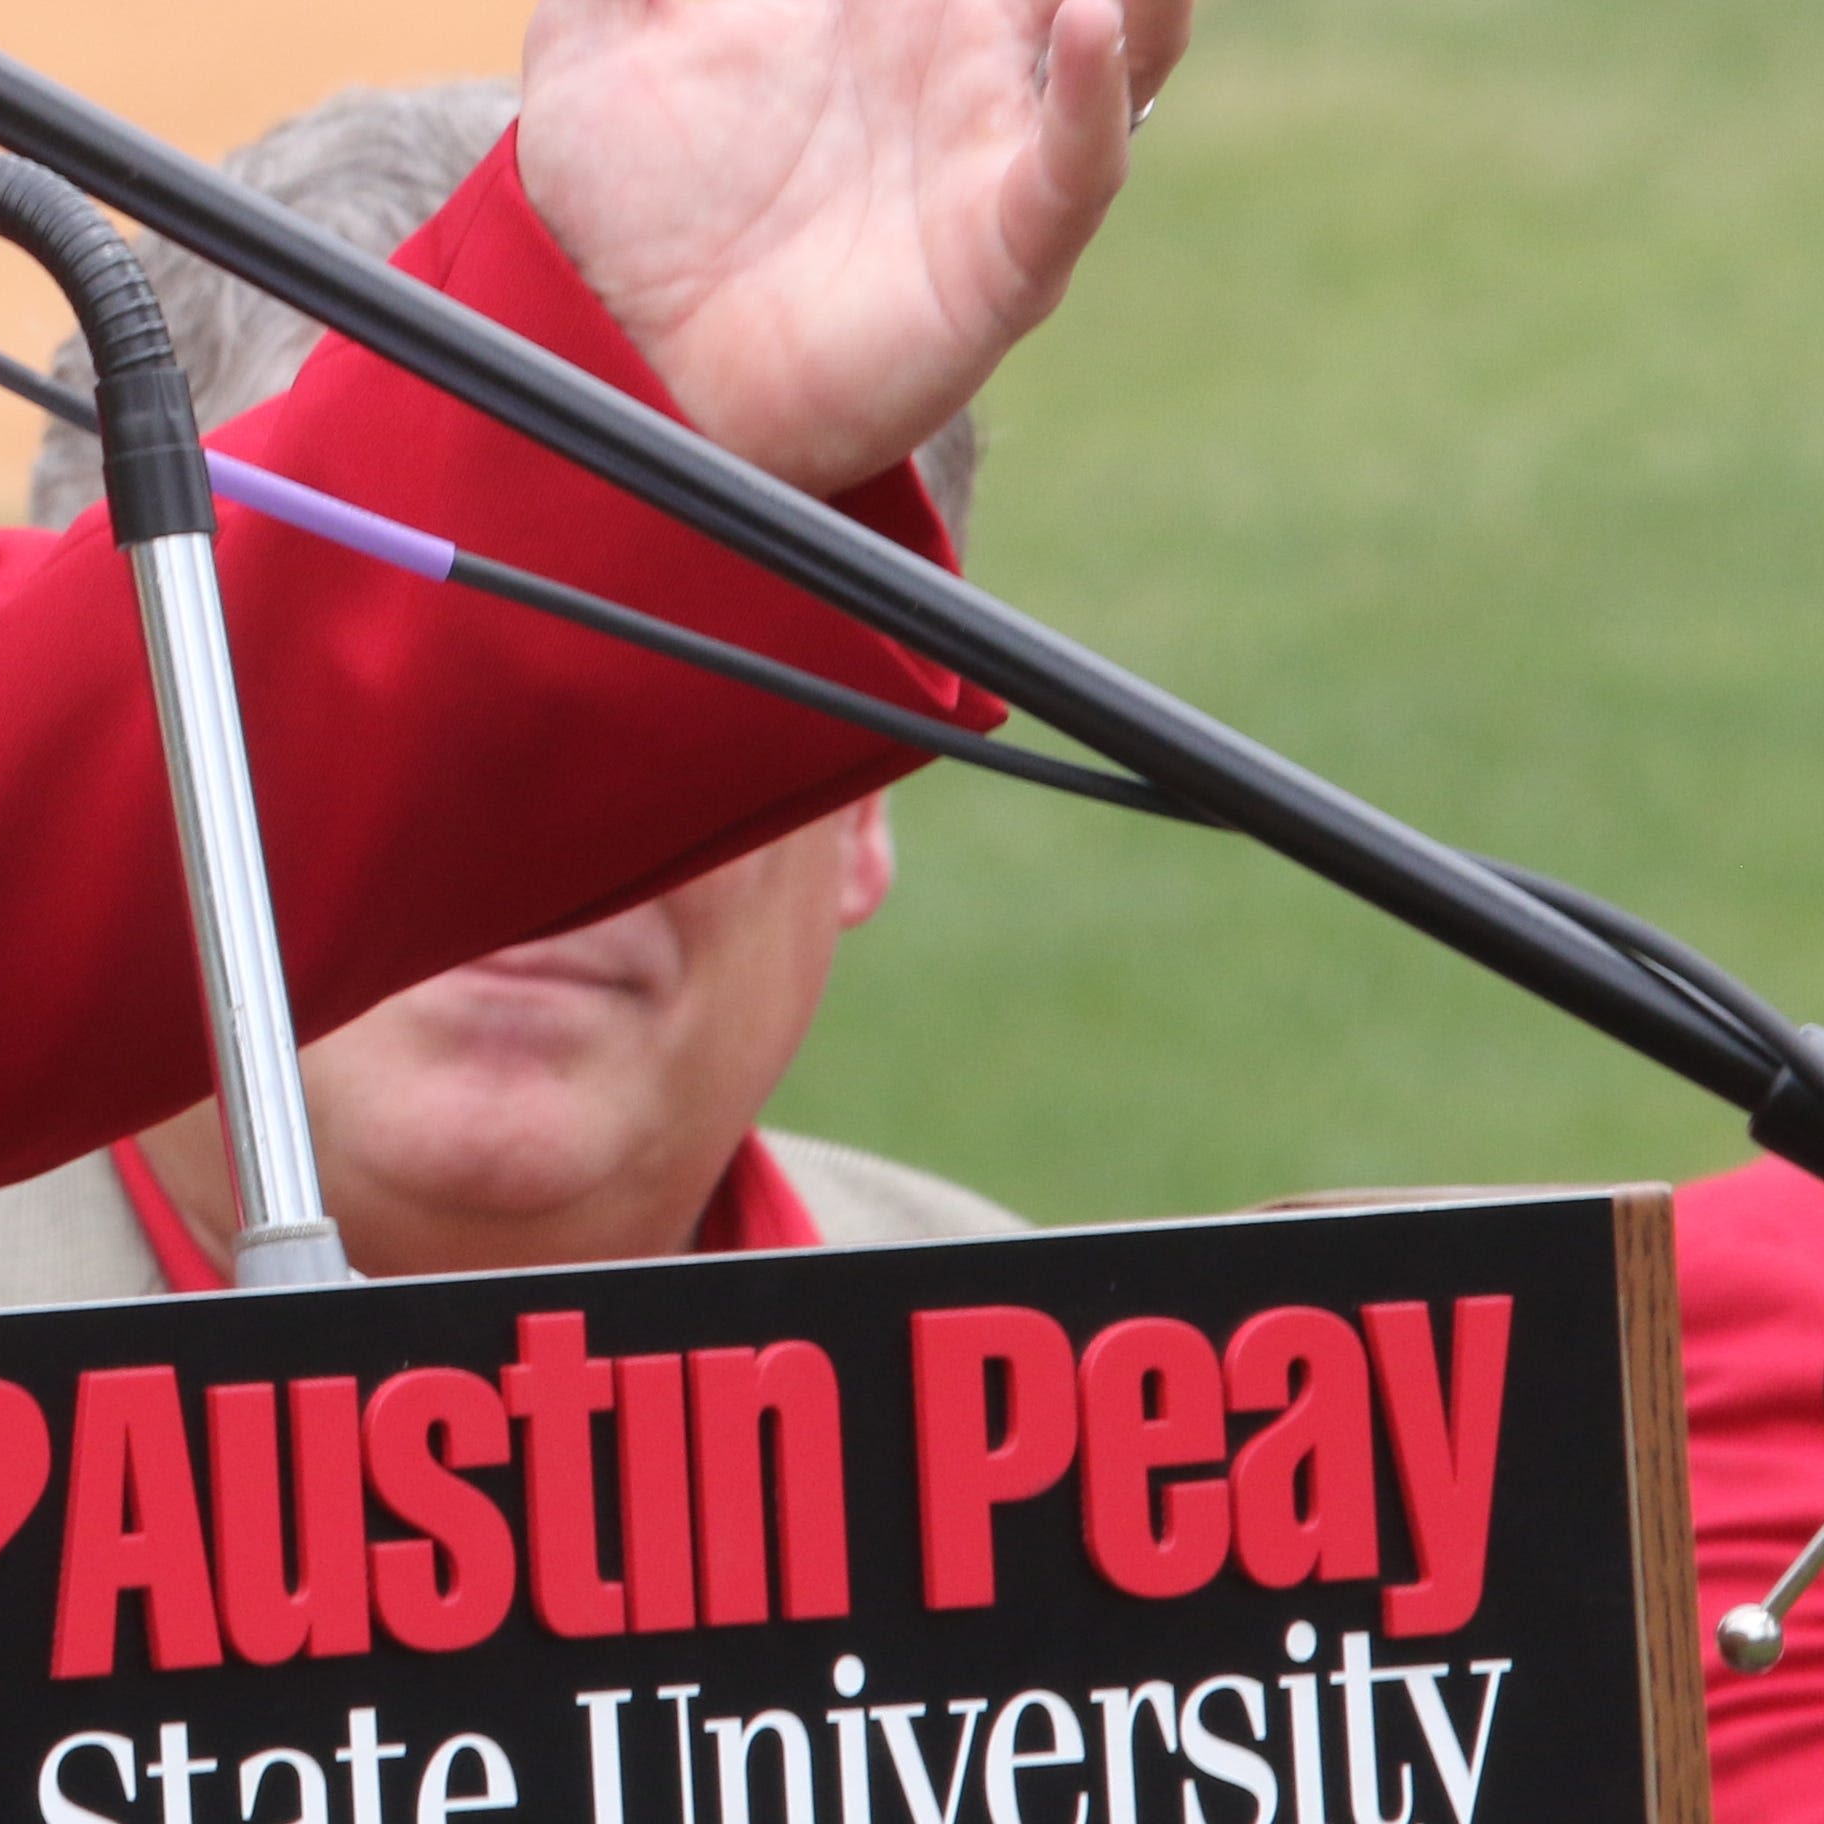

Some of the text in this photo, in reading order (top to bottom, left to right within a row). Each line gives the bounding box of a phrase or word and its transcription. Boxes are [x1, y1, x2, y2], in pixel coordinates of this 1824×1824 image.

[50, 1294, 1514, 1679] Austin Peay
[575, 1619, 1513, 1824] University
